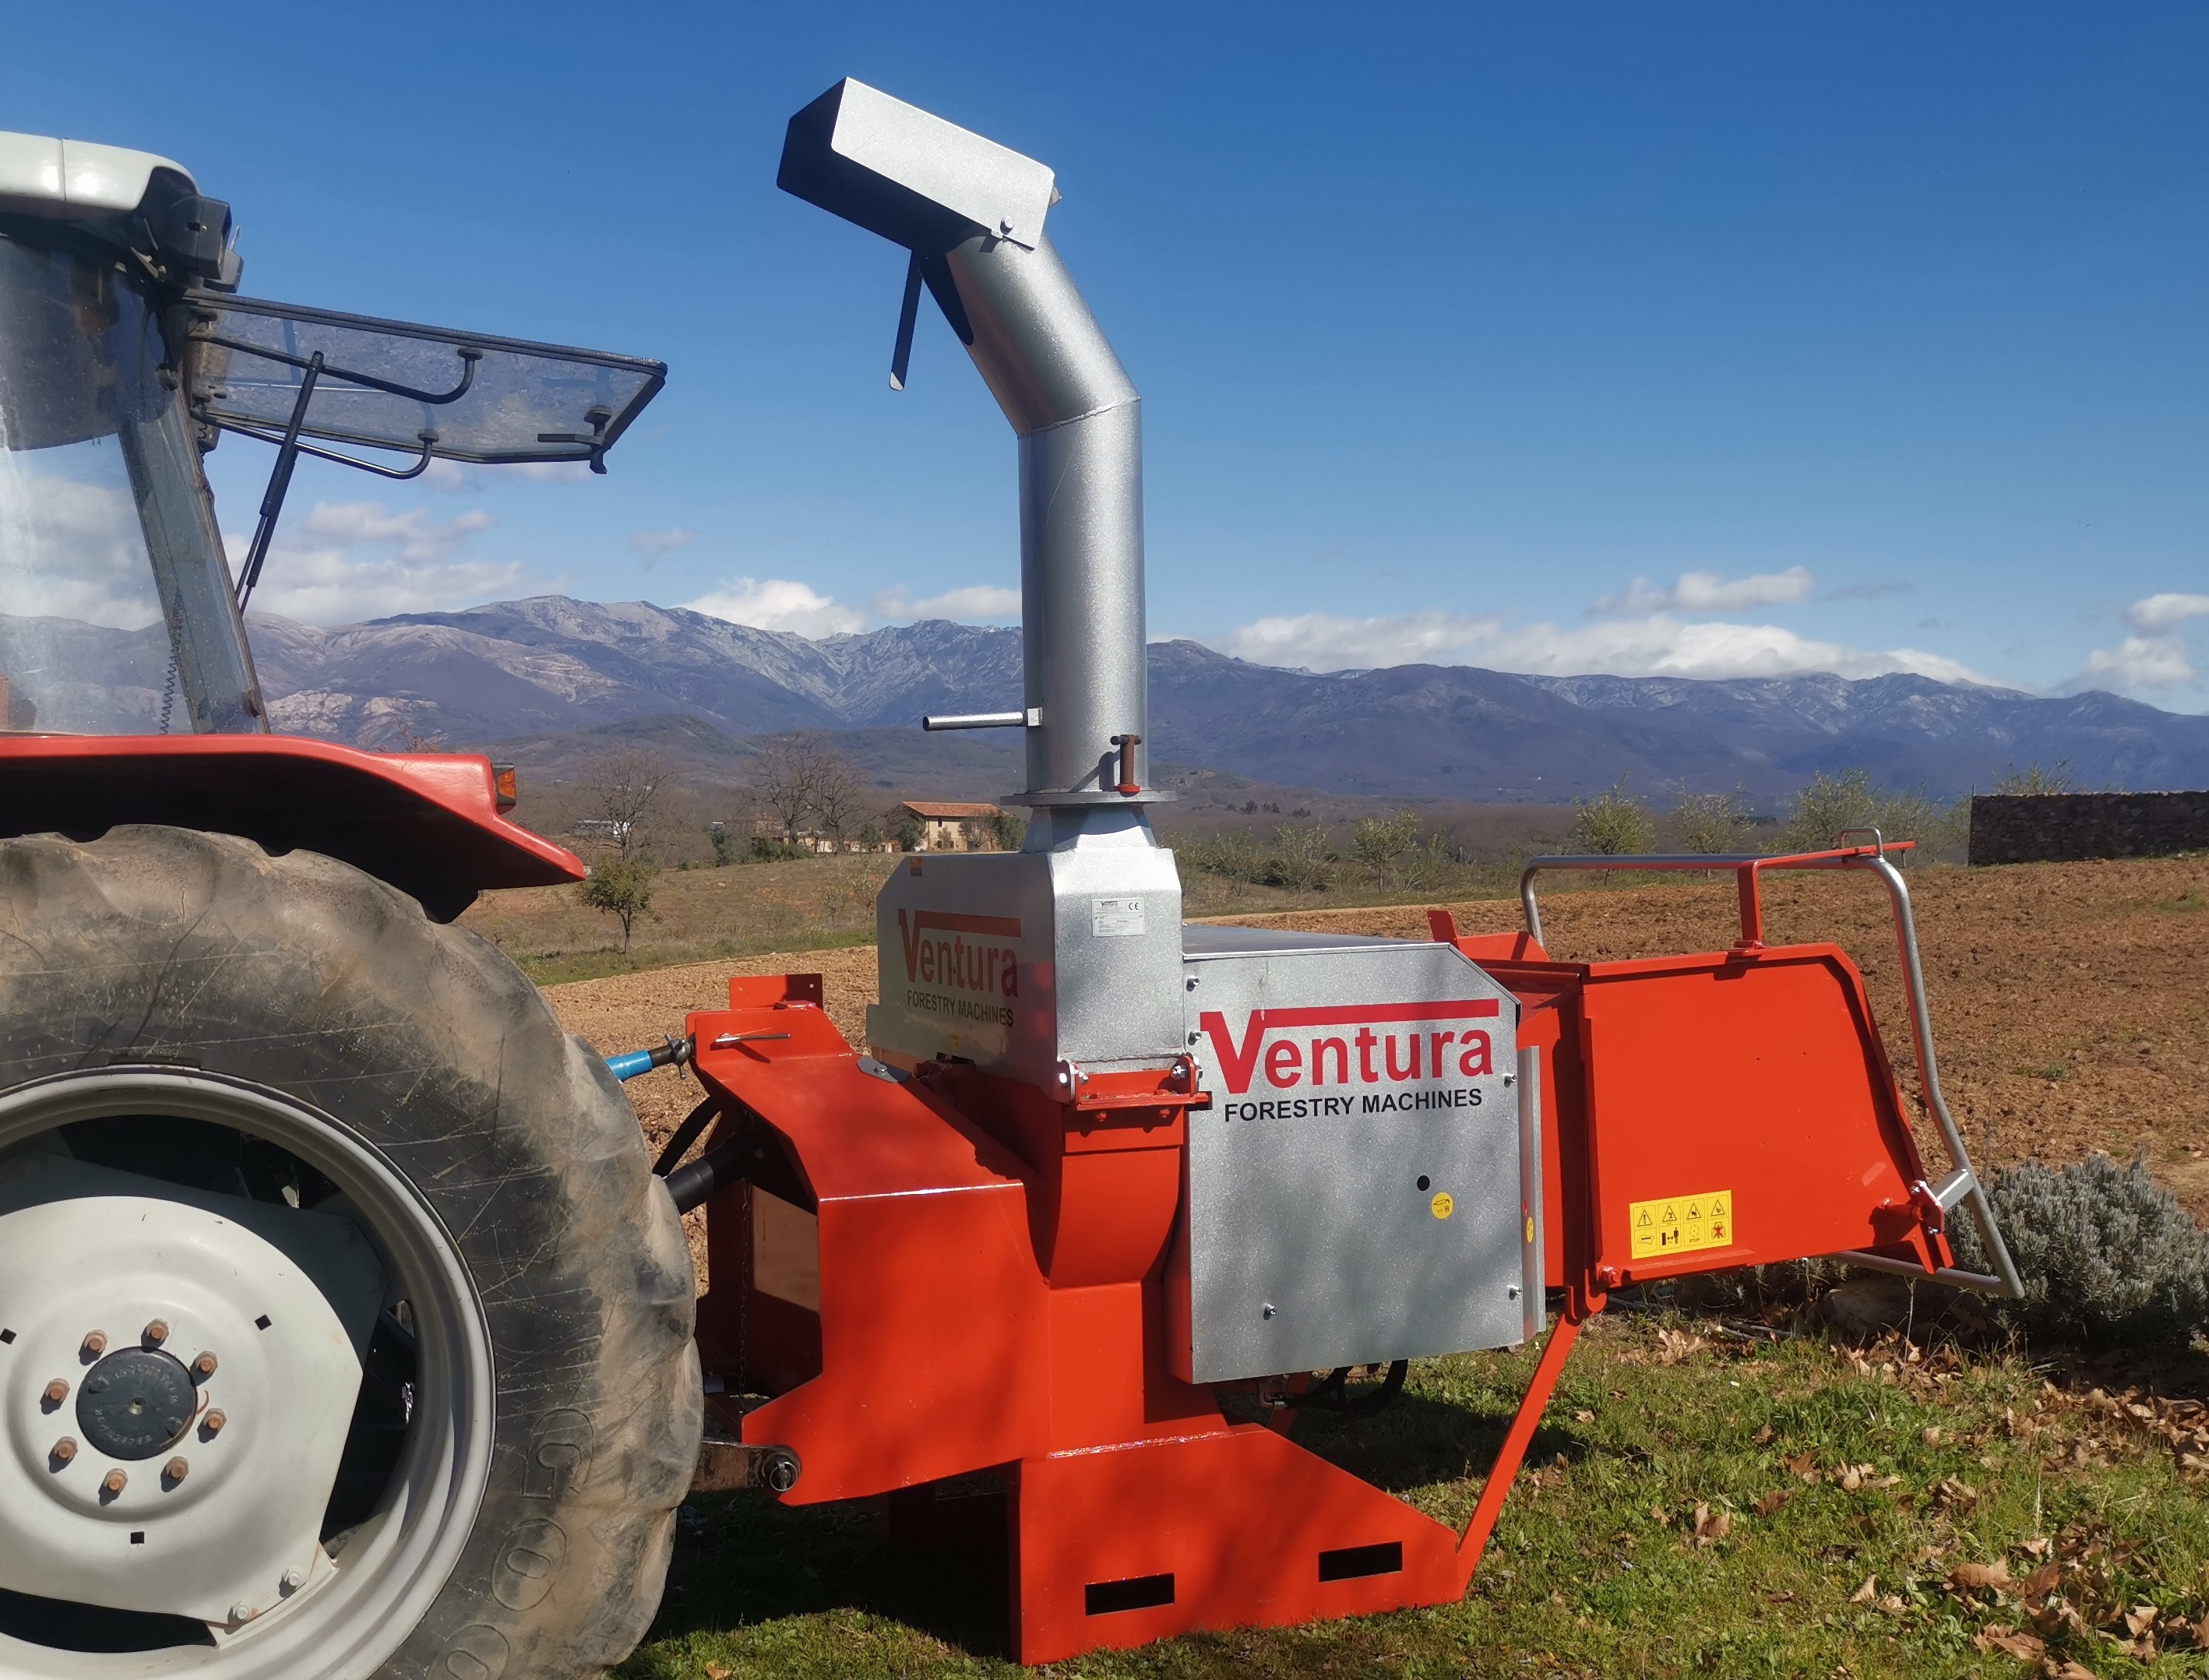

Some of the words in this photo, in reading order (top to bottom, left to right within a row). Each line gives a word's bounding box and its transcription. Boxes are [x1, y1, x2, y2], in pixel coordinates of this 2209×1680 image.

[898, 908, 1021, 998] Ventura
[907, 989, 956, 1015] FORESTRY
[958, 1000, 1014, 1027] MACHINES
[1200, 998, 1499, 1094] Ventura
[1224, 1096, 1355, 1122] FORESTRY
[1362, 1088, 1483, 1114] MACHINES
